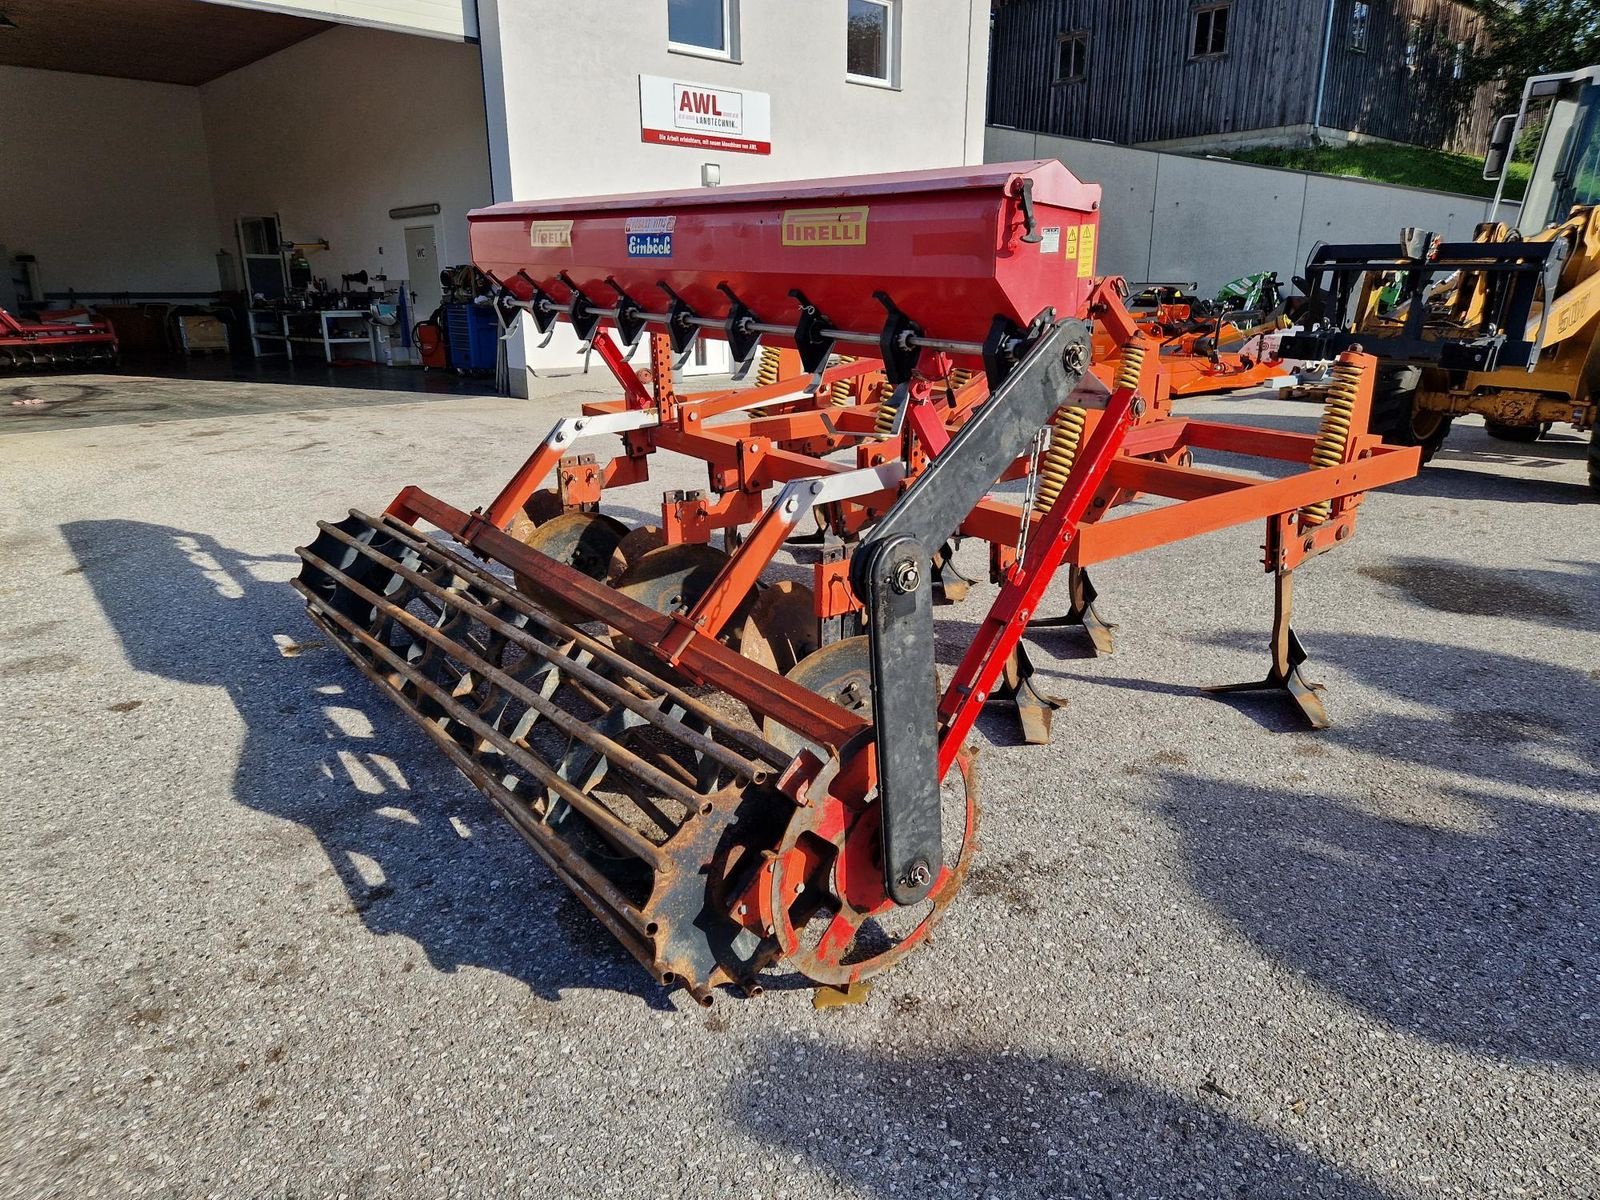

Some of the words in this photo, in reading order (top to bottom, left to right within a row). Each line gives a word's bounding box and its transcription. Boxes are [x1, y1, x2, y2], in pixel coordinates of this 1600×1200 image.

[680, 90, 722, 116] AWL
[696, 116, 736, 128] LANDTECHNIK
[667, 134, 679, 142] Arbeit
[786, 213, 861, 240] PIRELLI
[416, 248, 425, 257] WC
[629, 236, 671, 254] Einböck
